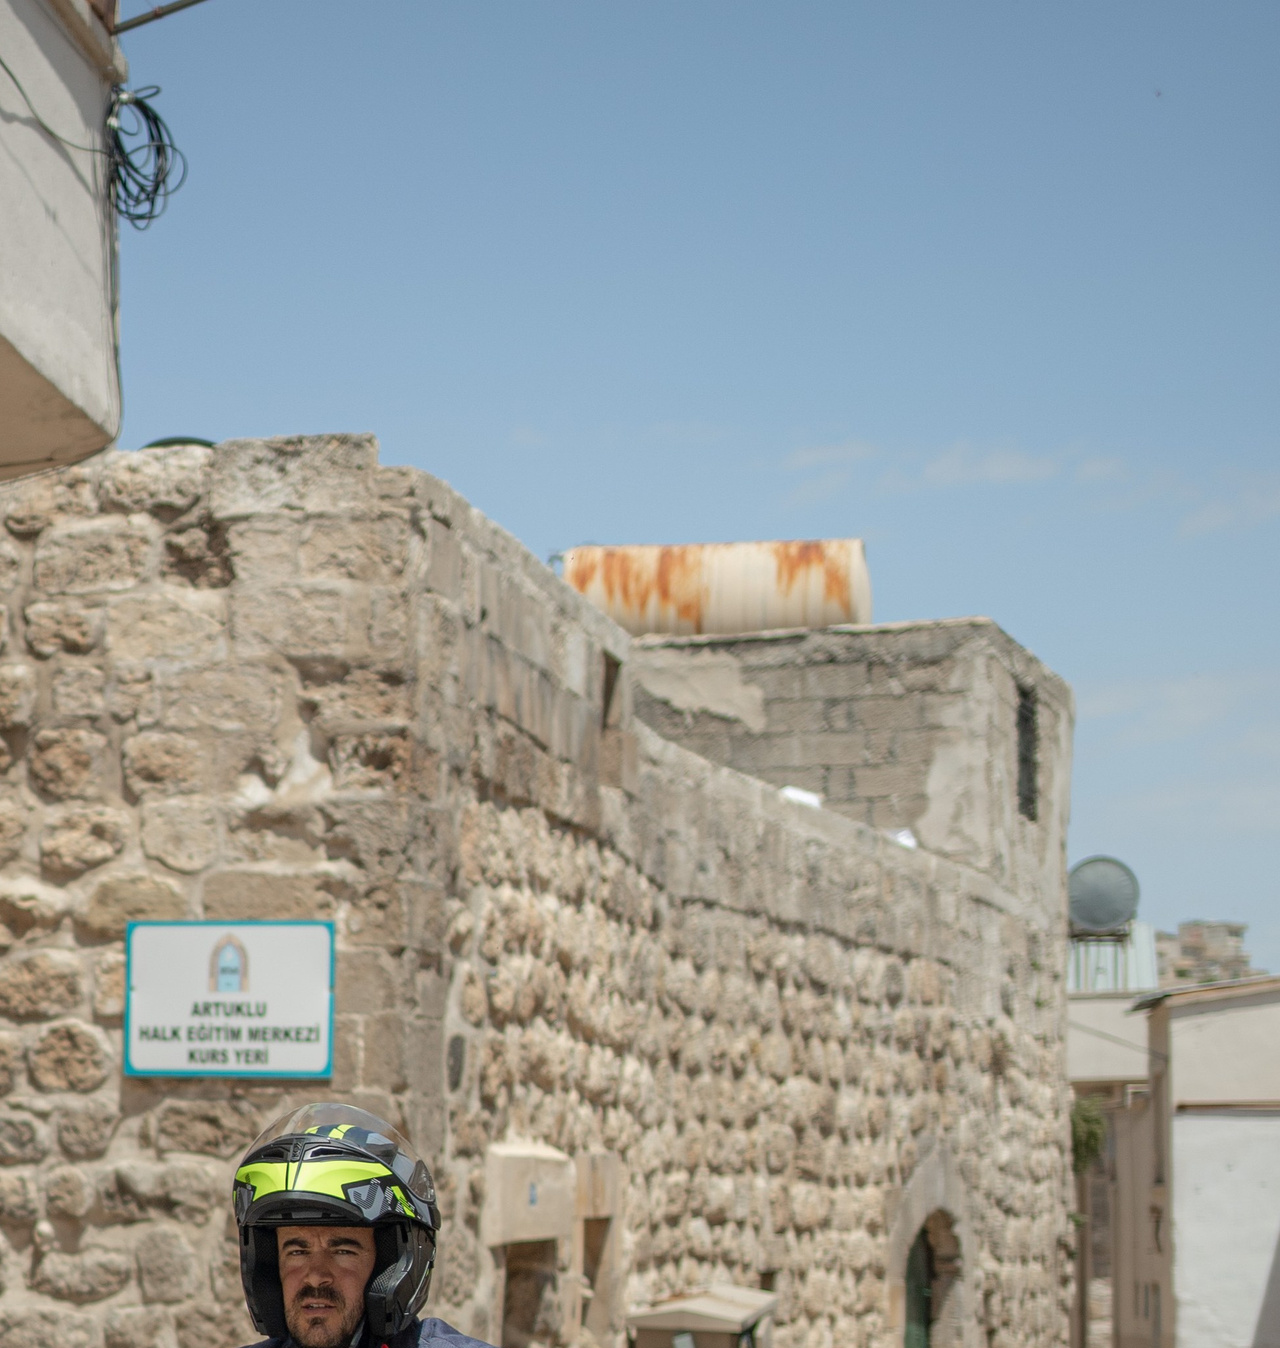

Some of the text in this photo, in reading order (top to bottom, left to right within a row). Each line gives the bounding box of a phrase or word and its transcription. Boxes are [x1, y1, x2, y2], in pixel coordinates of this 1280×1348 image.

[191, 1002, 267, 1017] ARTUKLU
[139, 1023, 320, 1042] HALK EĞİTİM MERKEZİ
[187, 1049, 269, 1064] KURS YERİ
